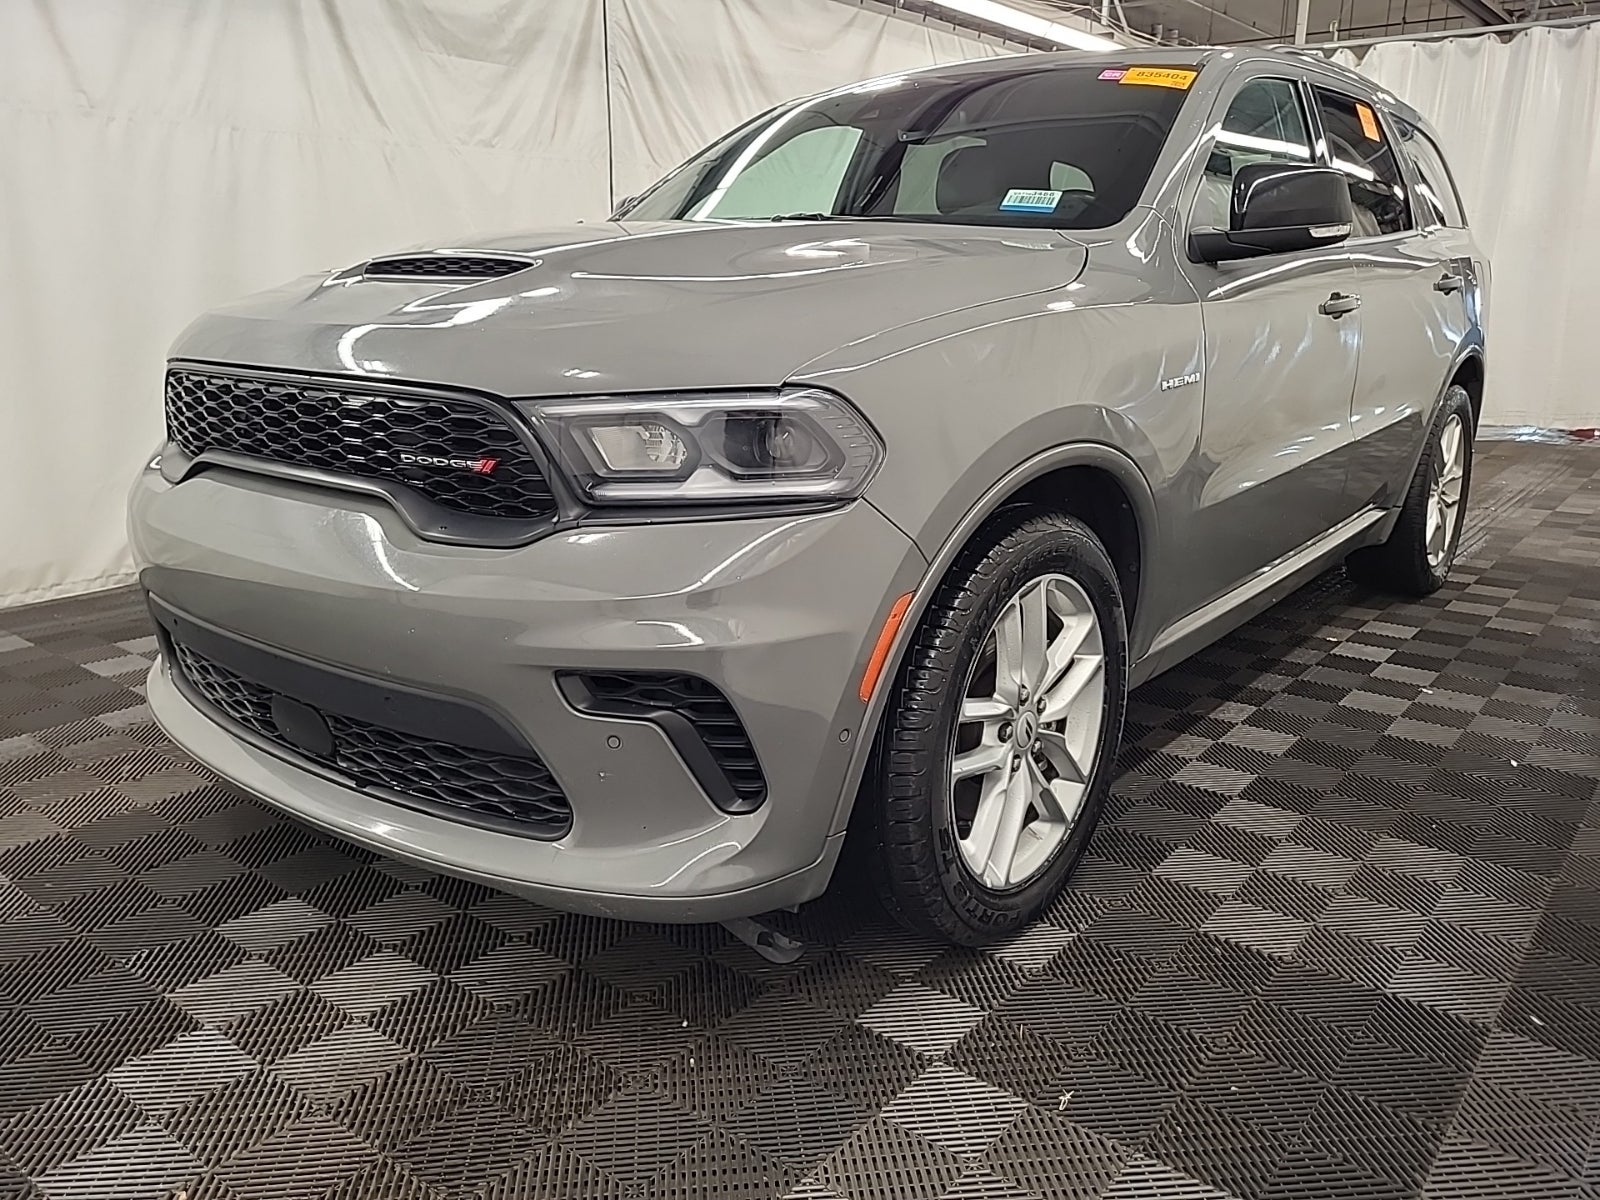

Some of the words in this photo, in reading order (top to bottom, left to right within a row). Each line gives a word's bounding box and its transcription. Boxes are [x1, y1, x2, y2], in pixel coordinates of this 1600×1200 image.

[1136, 71, 1188, 81] 835404
[1161, 372, 1200, 391] HEMI
[400, 453, 482, 469] DODGE
